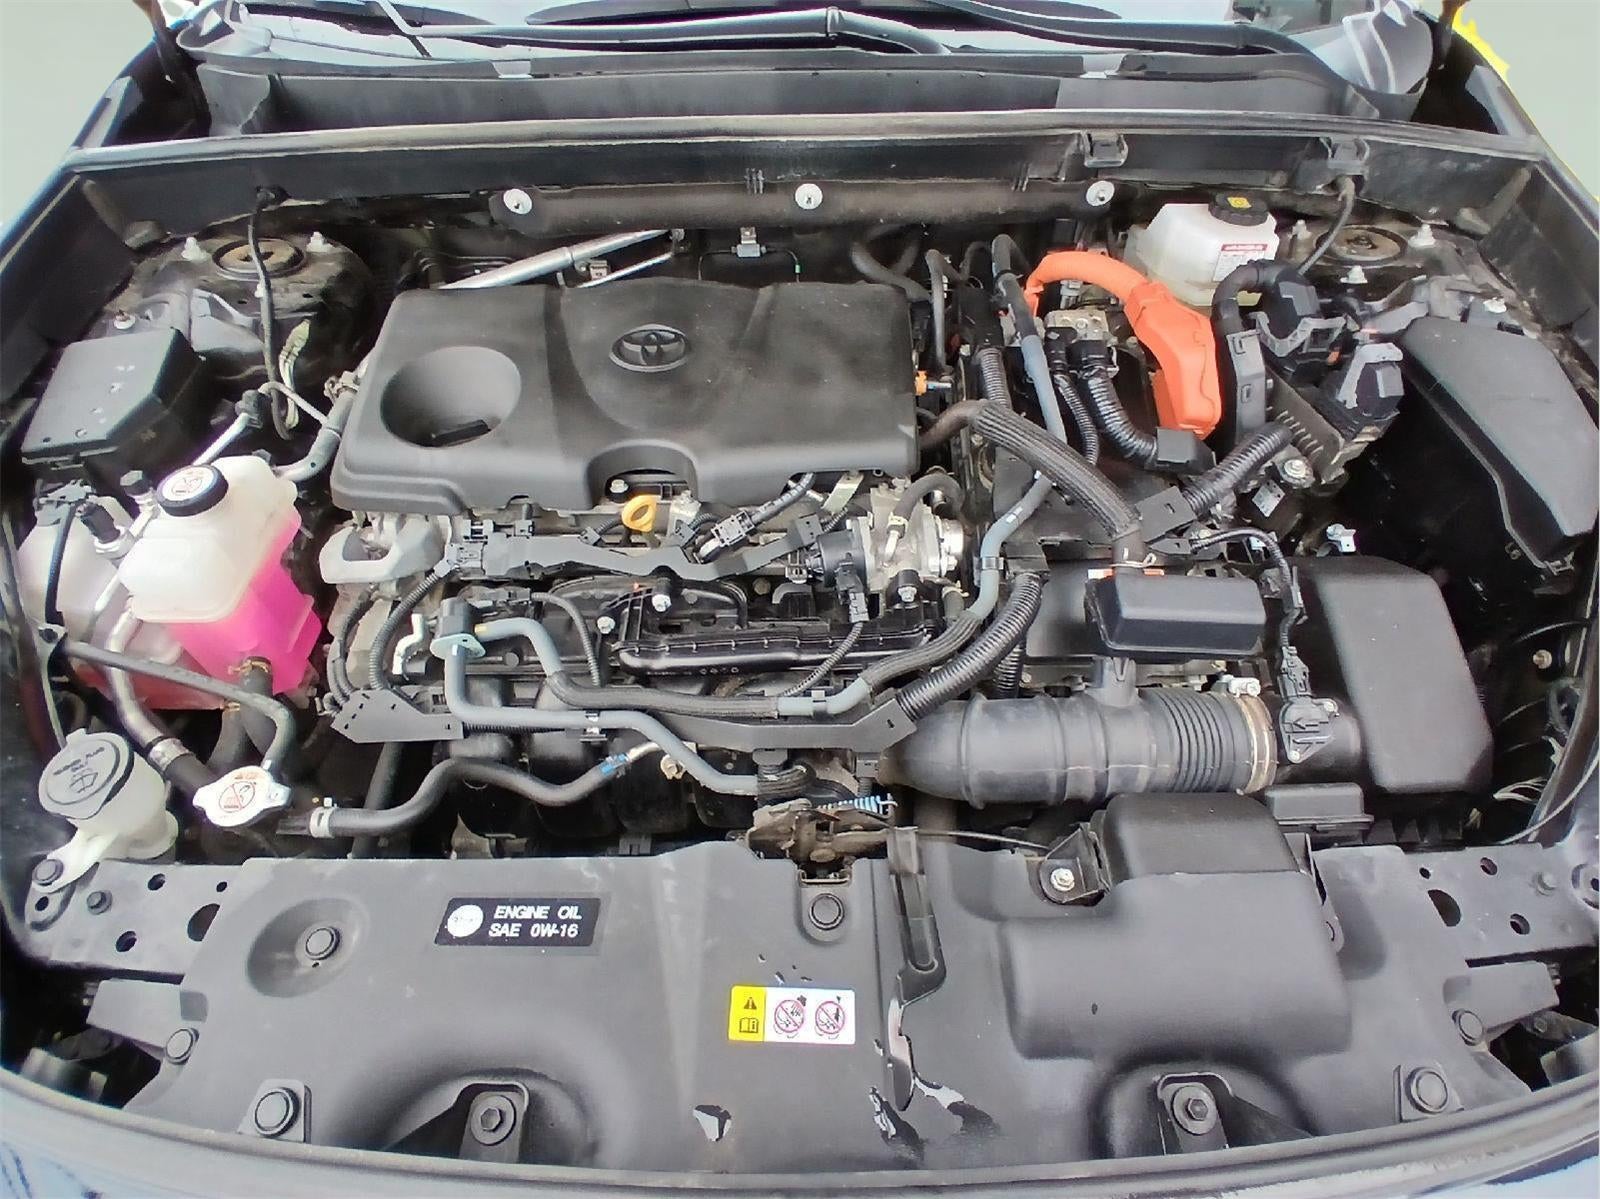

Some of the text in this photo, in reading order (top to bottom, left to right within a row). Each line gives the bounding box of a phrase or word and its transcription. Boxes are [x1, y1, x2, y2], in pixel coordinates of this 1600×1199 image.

[493, 905, 582, 920] ENGINE OIL
[488, 923, 579, 938] SAE 0W-16
